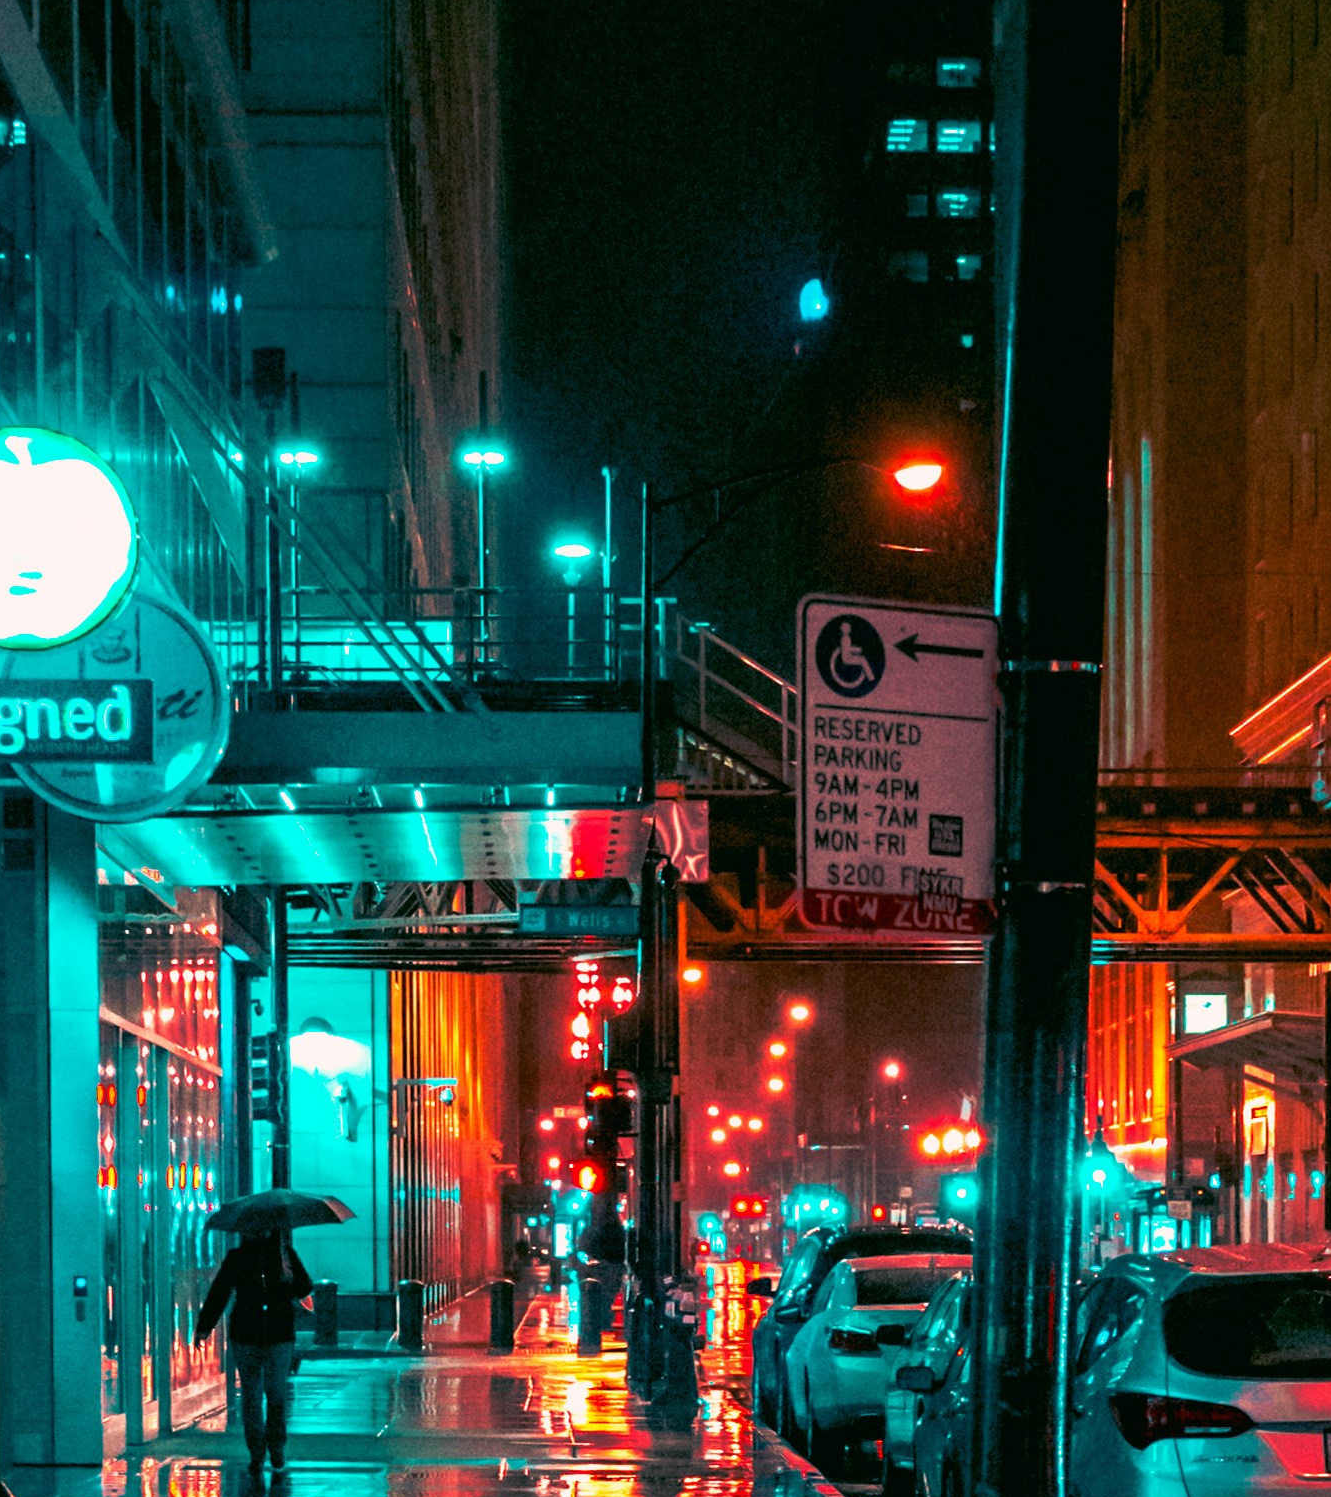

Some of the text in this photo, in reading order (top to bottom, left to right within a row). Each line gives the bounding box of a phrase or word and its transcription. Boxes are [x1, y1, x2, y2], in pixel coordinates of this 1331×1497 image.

[814, 715, 921, 745] RESERVED
[814, 744, 902, 772] PARKING
[827, 863, 885, 888] $200
[568, 910, 610, 929] Wells
